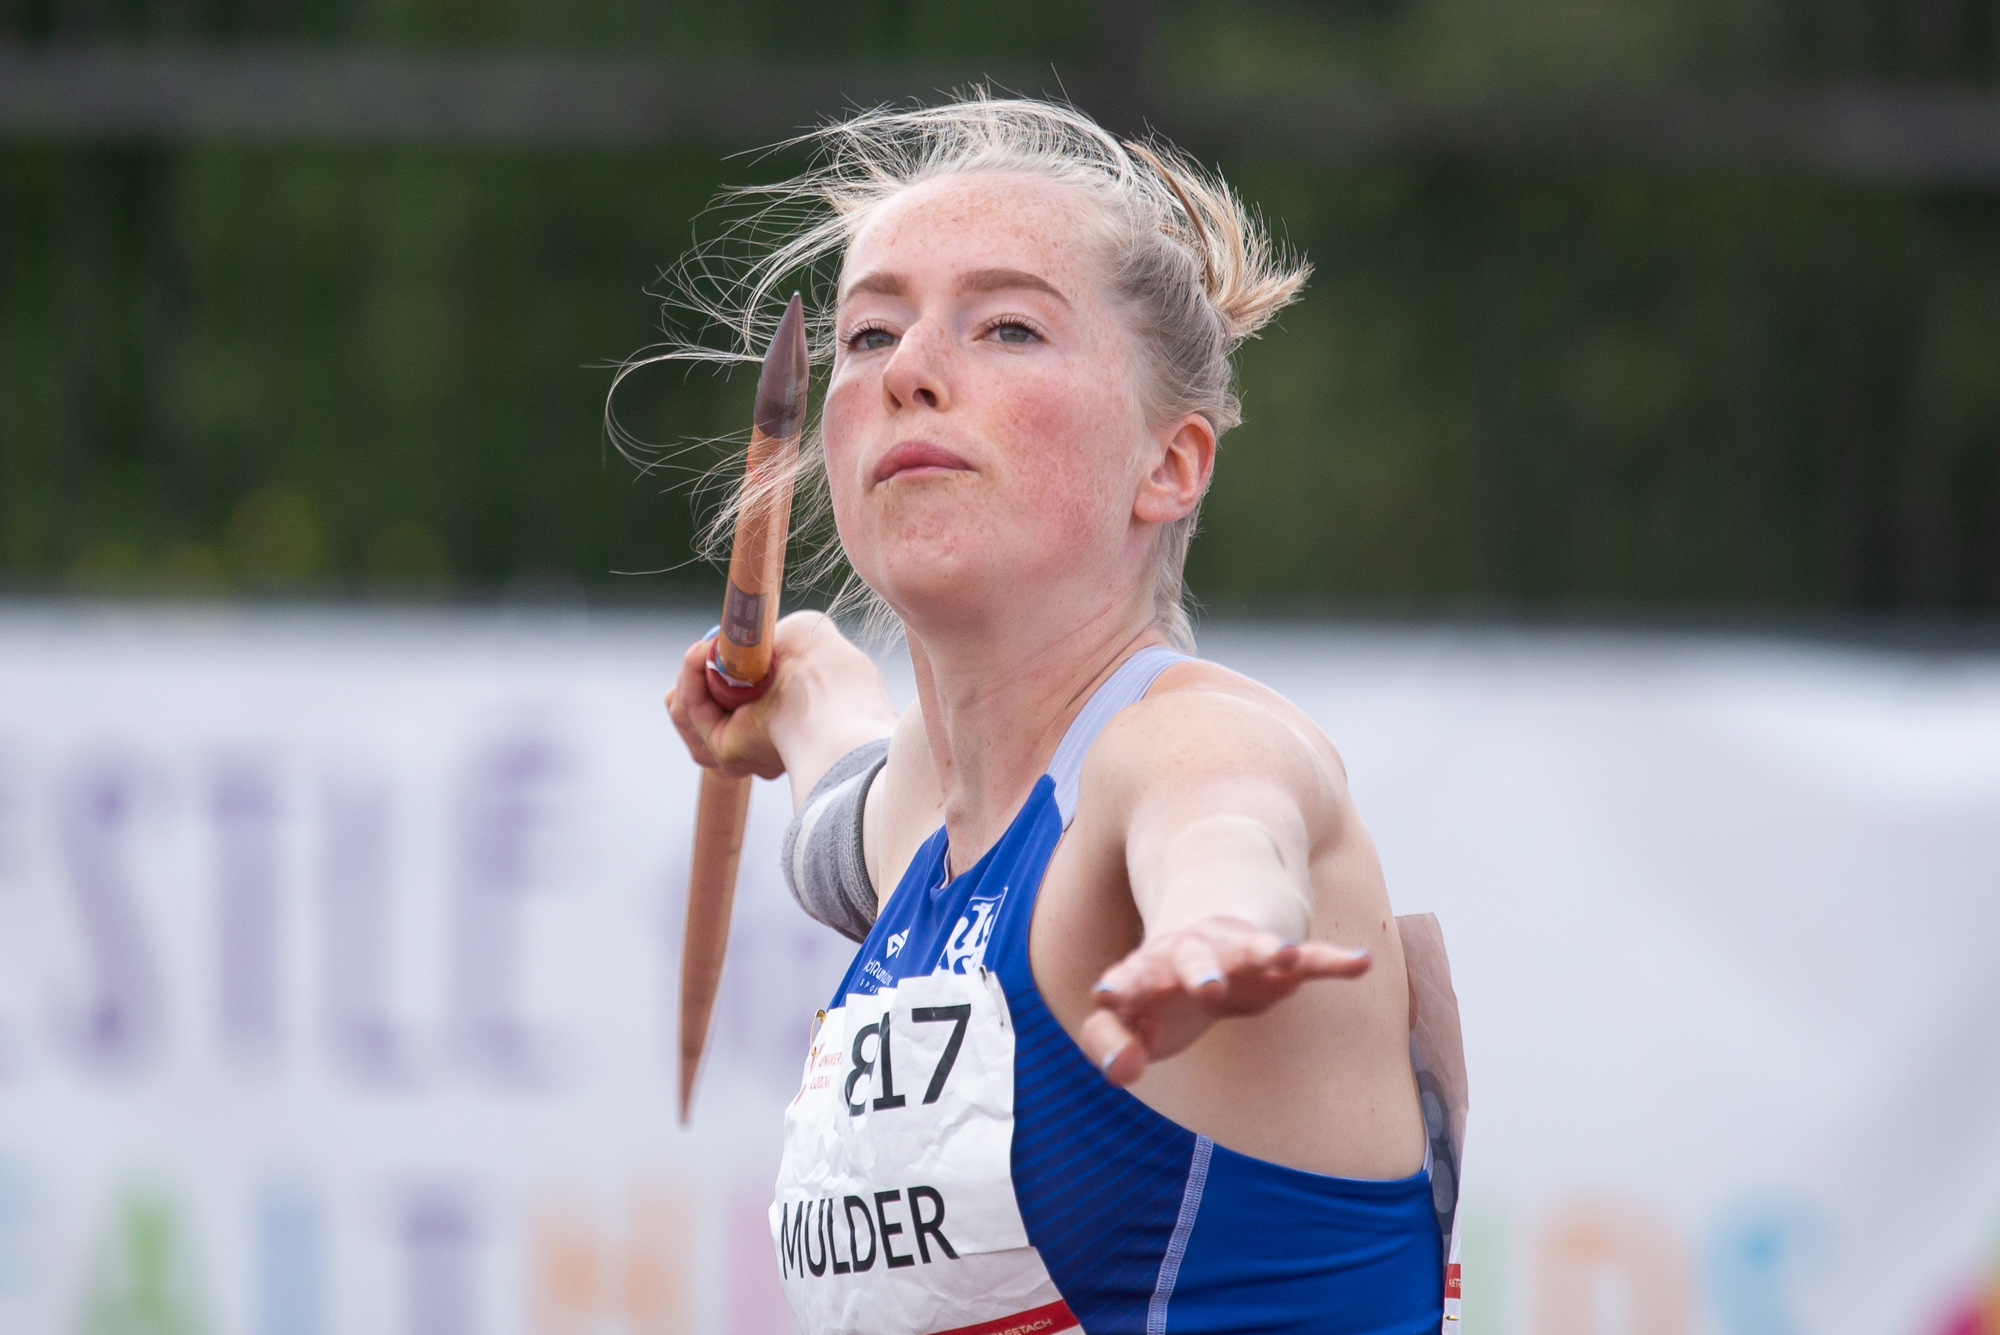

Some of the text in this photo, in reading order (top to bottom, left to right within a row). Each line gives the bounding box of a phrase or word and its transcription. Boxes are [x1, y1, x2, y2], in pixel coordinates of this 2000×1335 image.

[0, 725, 592, 1092] STLÉ
[845, 1004, 972, 1118] 817
[780, 1185, 961, 1281] MULDER
